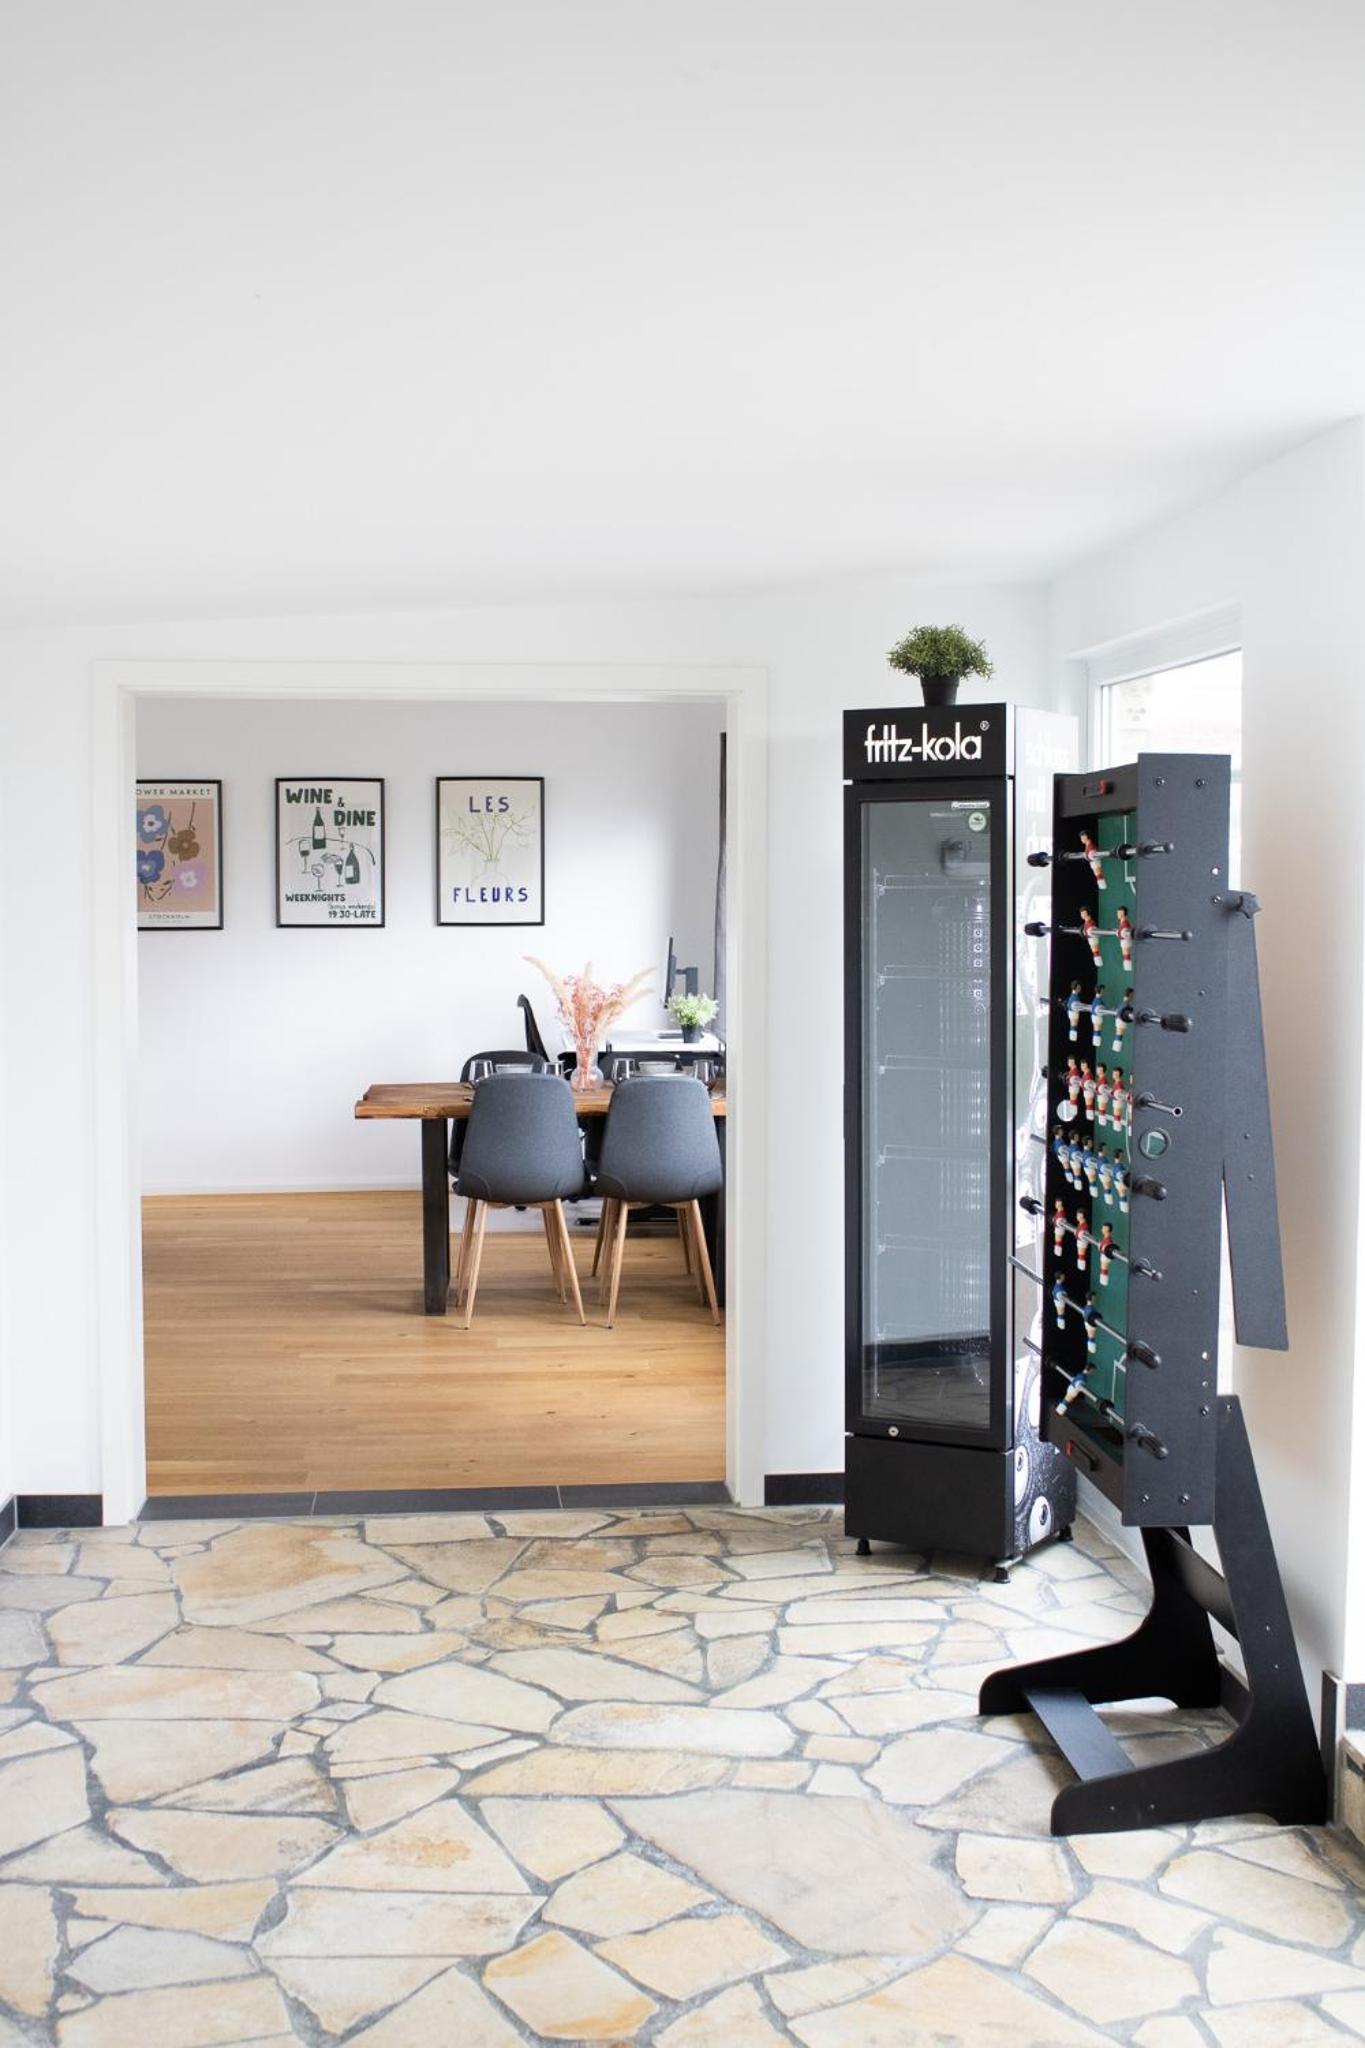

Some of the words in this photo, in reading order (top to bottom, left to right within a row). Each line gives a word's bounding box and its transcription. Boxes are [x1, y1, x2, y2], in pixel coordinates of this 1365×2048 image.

[136, 788, 164, 796] OWER
[169, 788, 211, 796] MARKET
[286, 788, 333, 804] WINE
[337, 797, 345, 807] &
[469, 796, 510, 813] LES
[333, 810, 376, 826] DINE
[285, 893, 346, 902] WEEKNIGHTS
[453, 887, 528, 903] FLEURS
